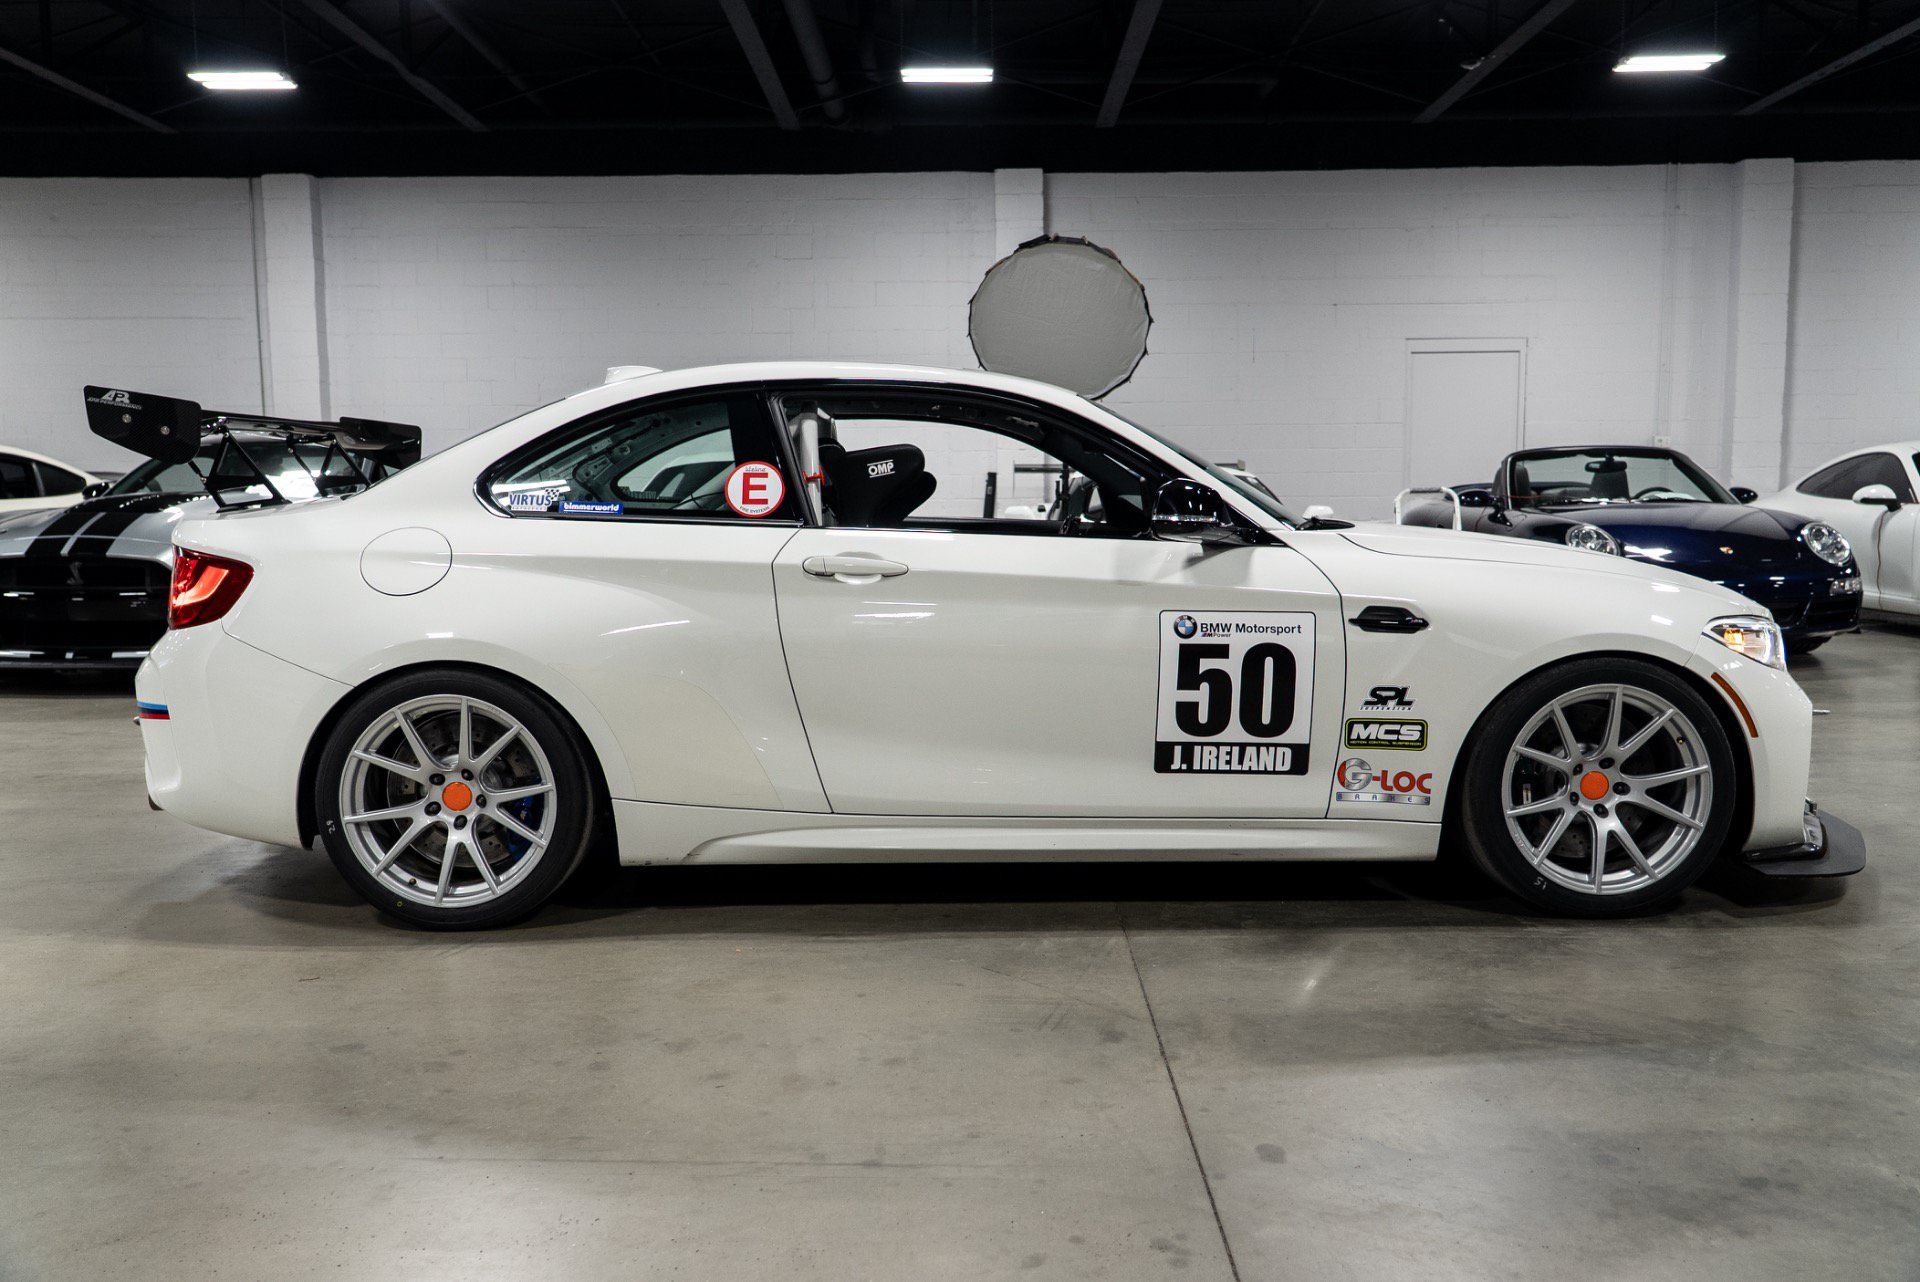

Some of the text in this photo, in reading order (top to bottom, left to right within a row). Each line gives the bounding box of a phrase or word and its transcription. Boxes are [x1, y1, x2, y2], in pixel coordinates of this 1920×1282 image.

[868, 462, 894, 476] OMP
[742, 472, 768, 505] E
[509, 494, 551, 506] VIRTUS
[564, 502, 619, 512] bimmerworld
[1200, 623, 1302, 635] BMW Motorsport
[1176, 642, 1296, 738] 50
[1363, 687, 1414, 706] SPL
[1350, 723, 1422, 741] MCS
[1170, 745, 1292, 771] J. IRELAND
[1337, 758, 1432, 794] G-LOC
[1337, 792, 1430, 804] BRAKES
